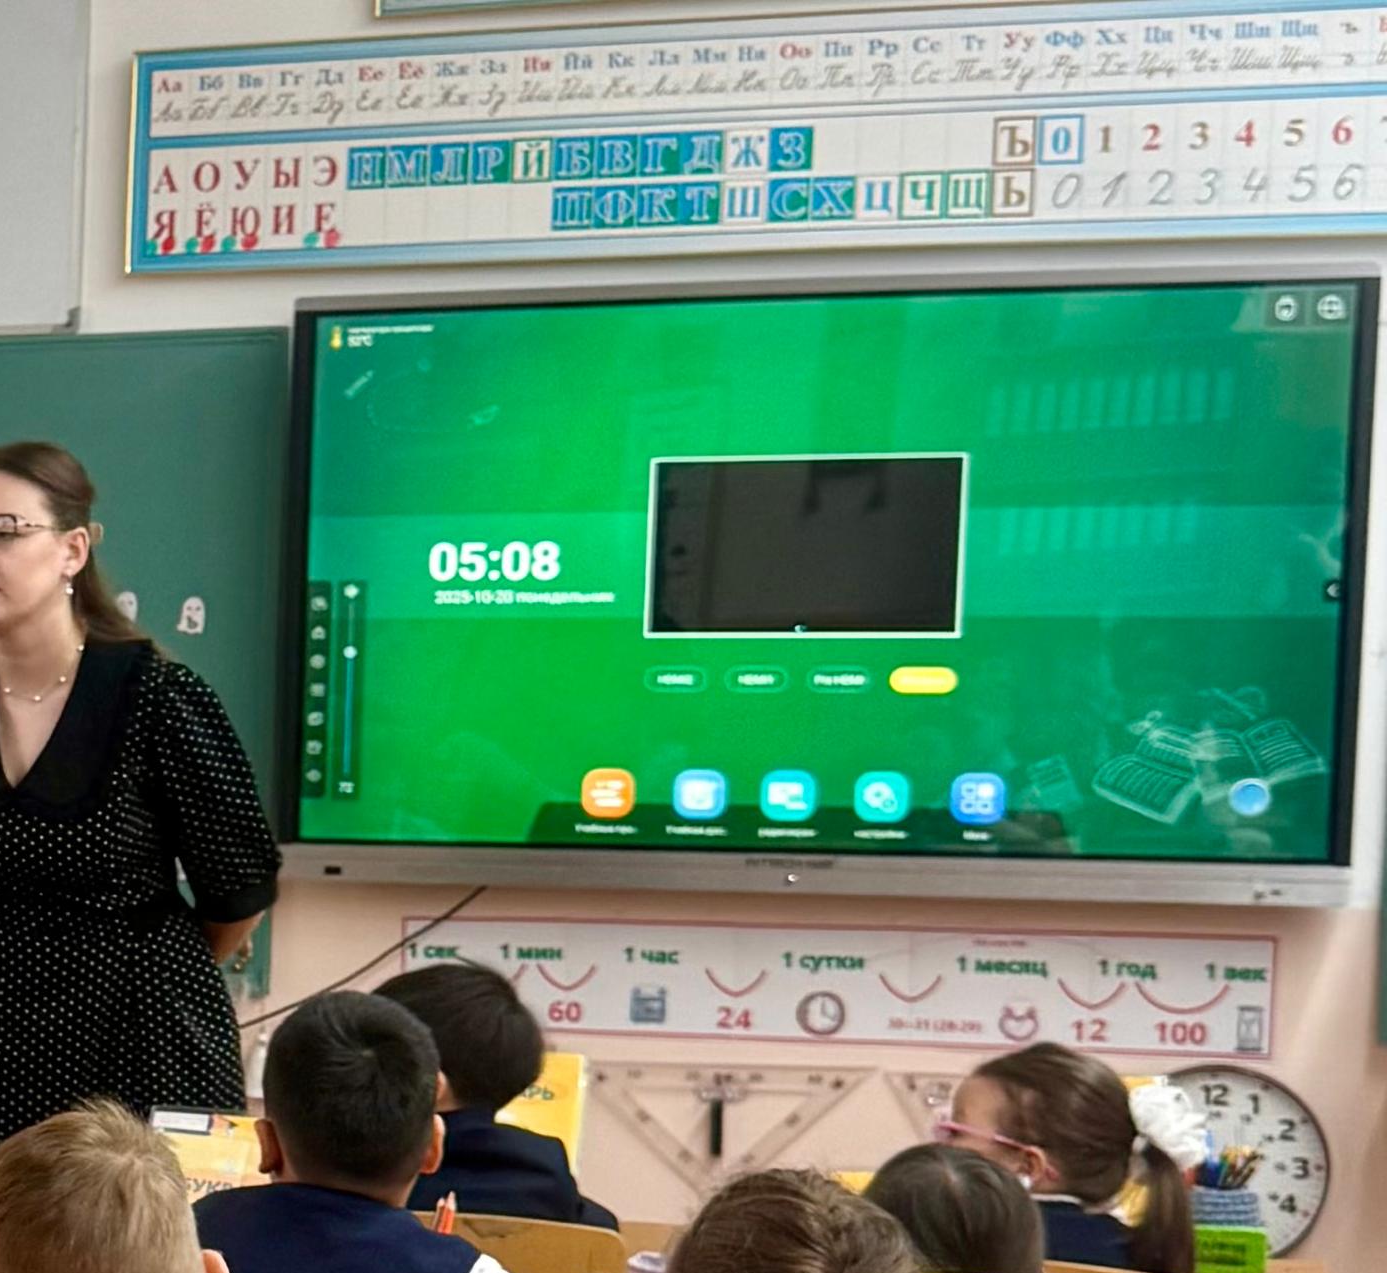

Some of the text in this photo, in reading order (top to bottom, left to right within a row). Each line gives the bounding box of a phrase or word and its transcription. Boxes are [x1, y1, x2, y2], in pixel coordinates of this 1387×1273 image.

[157, 78, 182, 93] Аа
[198, 74, 224, 92] Бб
[237, 73, 263, 89] Вв
[280, 71, 303, 87] Гг
[608, 51, 635, 68] Кк
[779, 43, 812, 59] Оо
[868, 39, 899, 59] Рр
[912, 36, 941, 53] Сс
[962, 35, 986, 51] Тт
[1003, 31, 1036, 52] Уу
[1045, 29, 1086, 49] Фф
[1096, 28, 1128, 45] Хх
[1052, 115, 1354, 153] 0 1 2 3 4 5 6
[153, 155, 338, 194] А О У Ы Э
[1052, 164, 1364, 209] 0 1 2 3 4 5 6
[152, 201, 338, 242] Я Ё Ю И Е
[428, 540, 560, 582] 05:08
[422, 945, 459, 959] сек
[515, 946, 564, 961] мин
[641, 949, 680, 965] час
[798, 955, 865, 972] сутки
[974, 959, 1049, 979] месяц
[1116, 963, 1157, 981] год
[1224, 966, 1268, 982] век
[547, 1001, 582, 1024] 60
[717, 1006, 752, 1030] 24
[1072, 1019, 1109, 1043] 12
[1155, 1021, 1208, 1046] 100
[1201, 1083, 1230, 1107] 12
[1249, 1093, 1260, 1115] 1
[1279, 1119, 1296, 1141] 2
[1292, 1157, 1310, 1179] 3
[1279, 1194, 1297, 1214] 4
